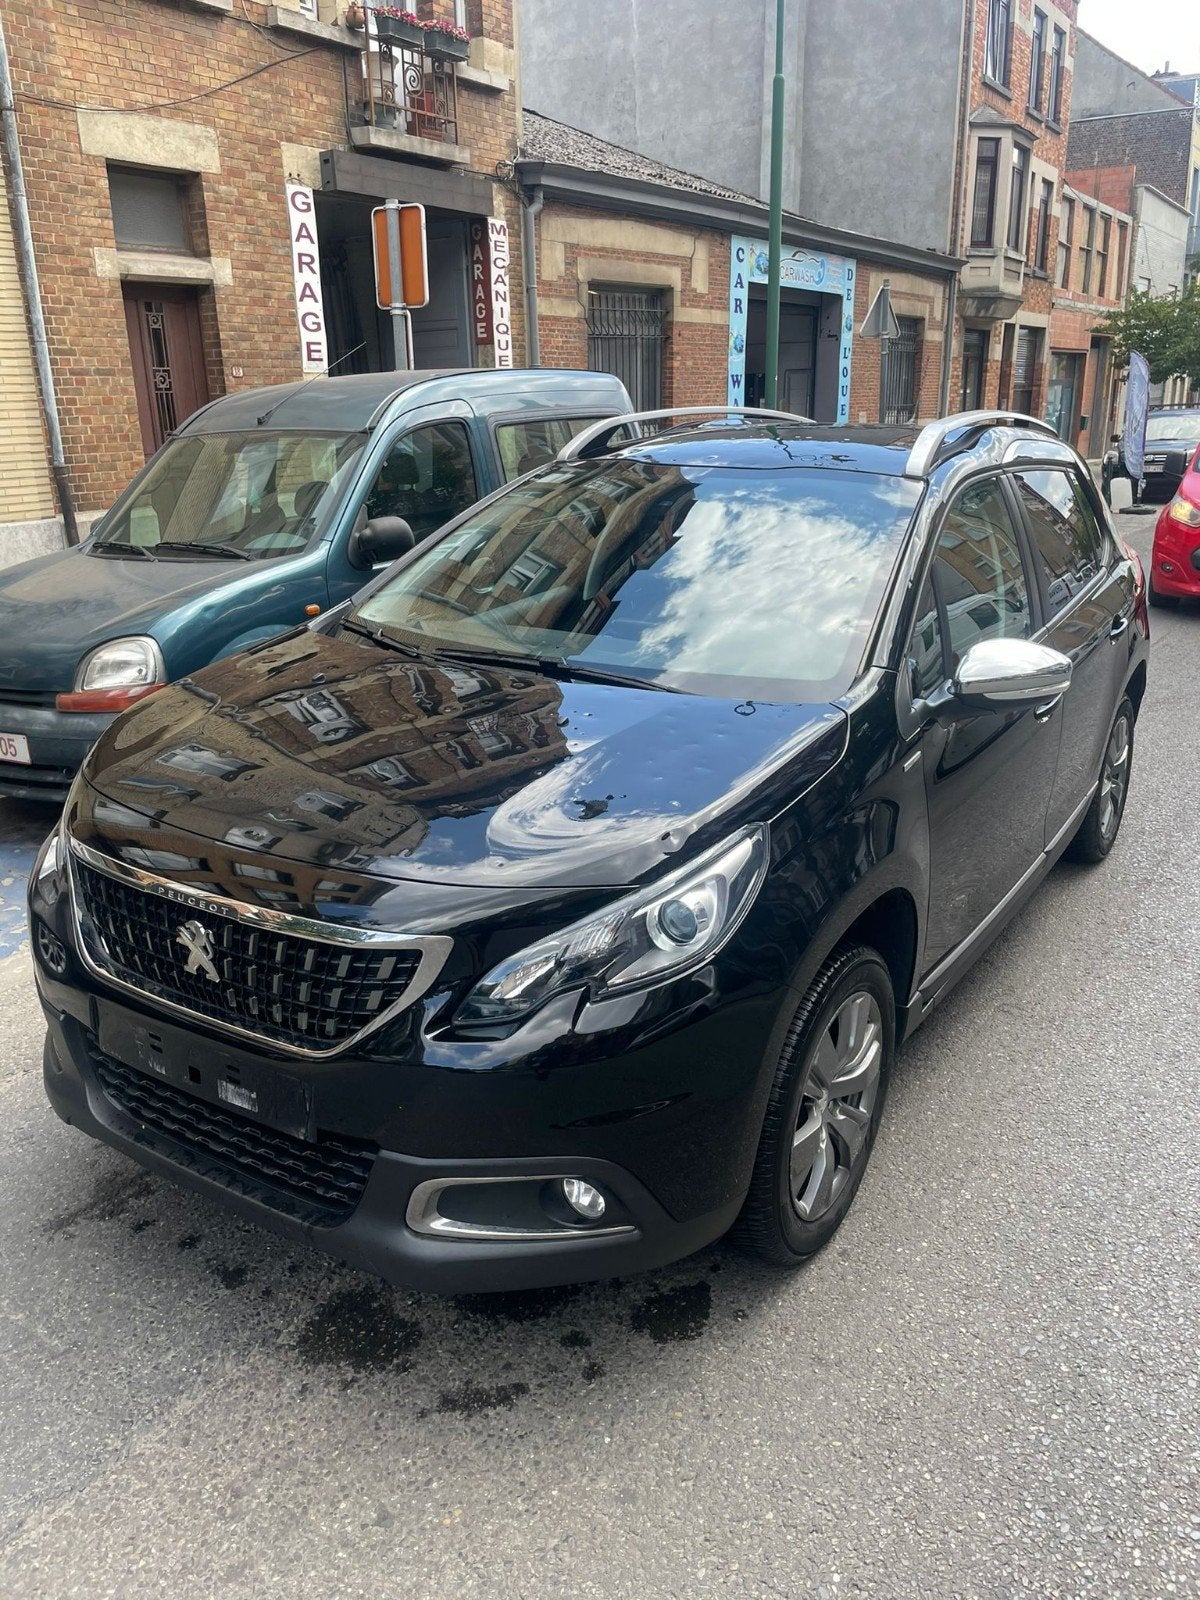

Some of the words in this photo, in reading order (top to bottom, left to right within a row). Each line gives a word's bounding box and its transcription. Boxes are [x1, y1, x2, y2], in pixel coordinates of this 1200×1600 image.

[290, 190, 324, 362] GARAGE
[471, 224, 488, 338] GARAGE
[490, 222, 510, 367] MECANIQUE
[734, 247, 745, 314] CAR
[846, 268, 854, 301] DE
[158, 886, 229, 915] PEUGEOT
